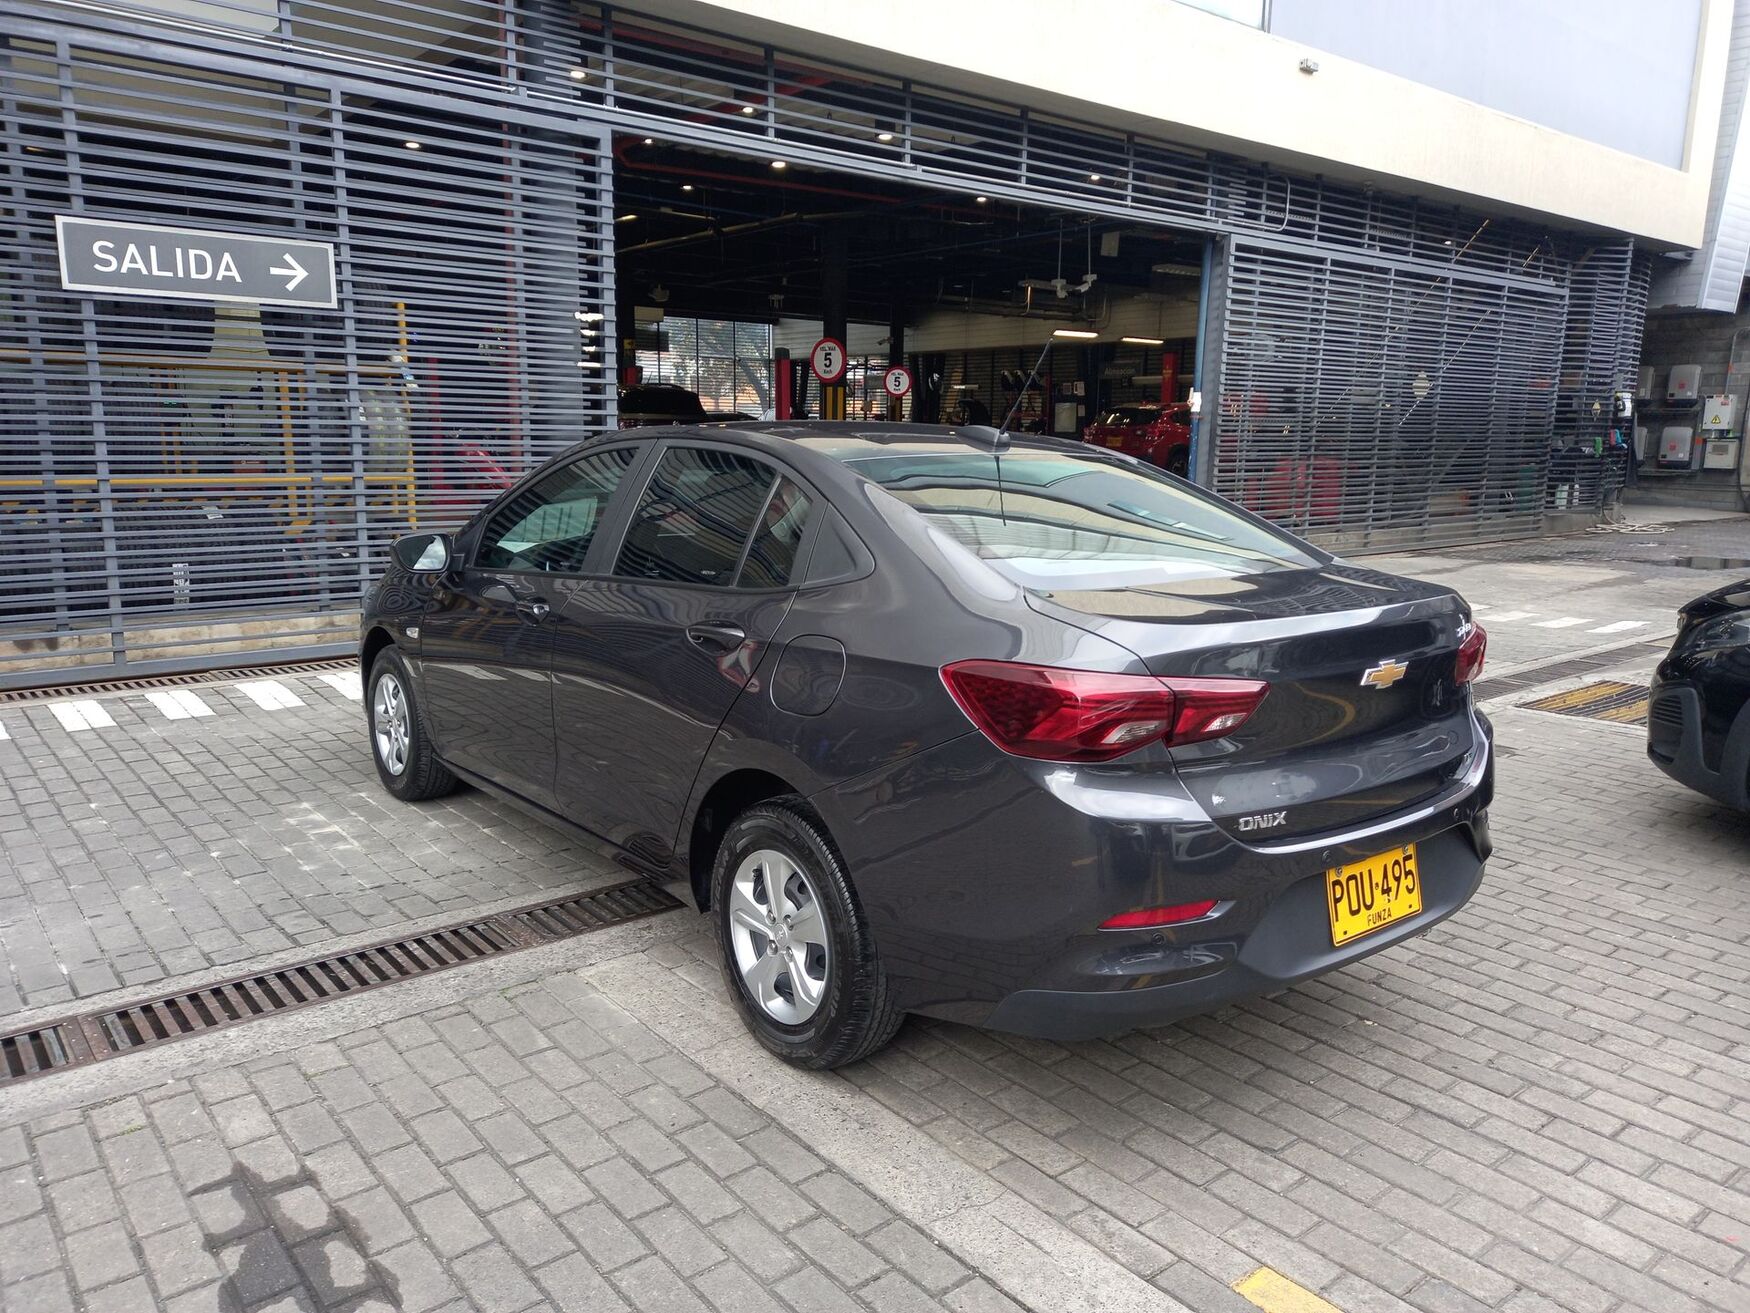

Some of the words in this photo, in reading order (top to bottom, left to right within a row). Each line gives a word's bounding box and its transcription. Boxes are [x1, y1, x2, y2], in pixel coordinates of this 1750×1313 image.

[92, 240, 242, 283] SALIDA
[823, 352, 832, 368] 5
[894, 376, 901, 387] 5
[1239, 811, 1287, 831] ONIX
[1367, 907, 1392, 926] FUNZA
